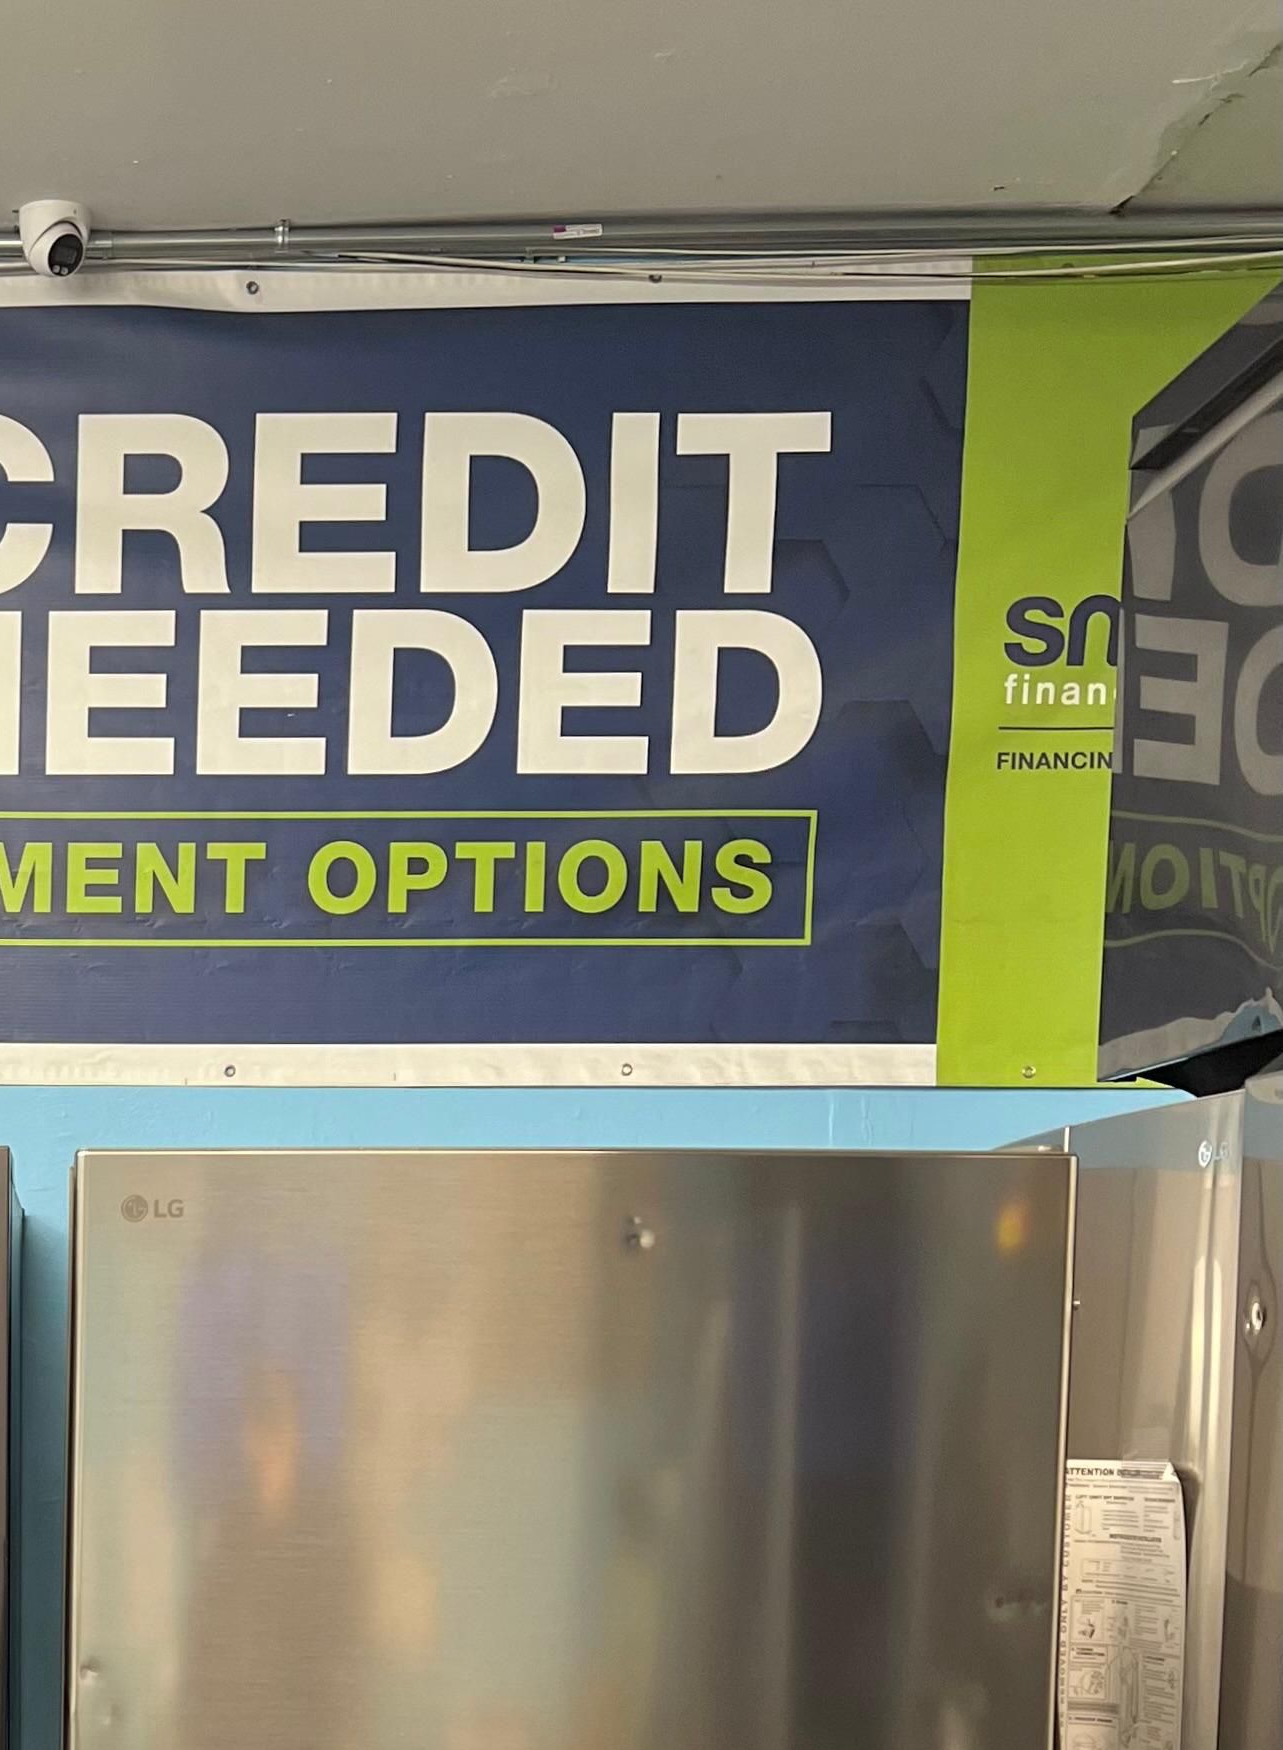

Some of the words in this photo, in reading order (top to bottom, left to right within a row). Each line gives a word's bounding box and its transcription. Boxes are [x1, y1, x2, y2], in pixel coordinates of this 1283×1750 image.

[1003, 673, 1116, 705] finan
[308, 838, 774, 914] OPTIONS
[153, 1199, 184, 1218] LG
